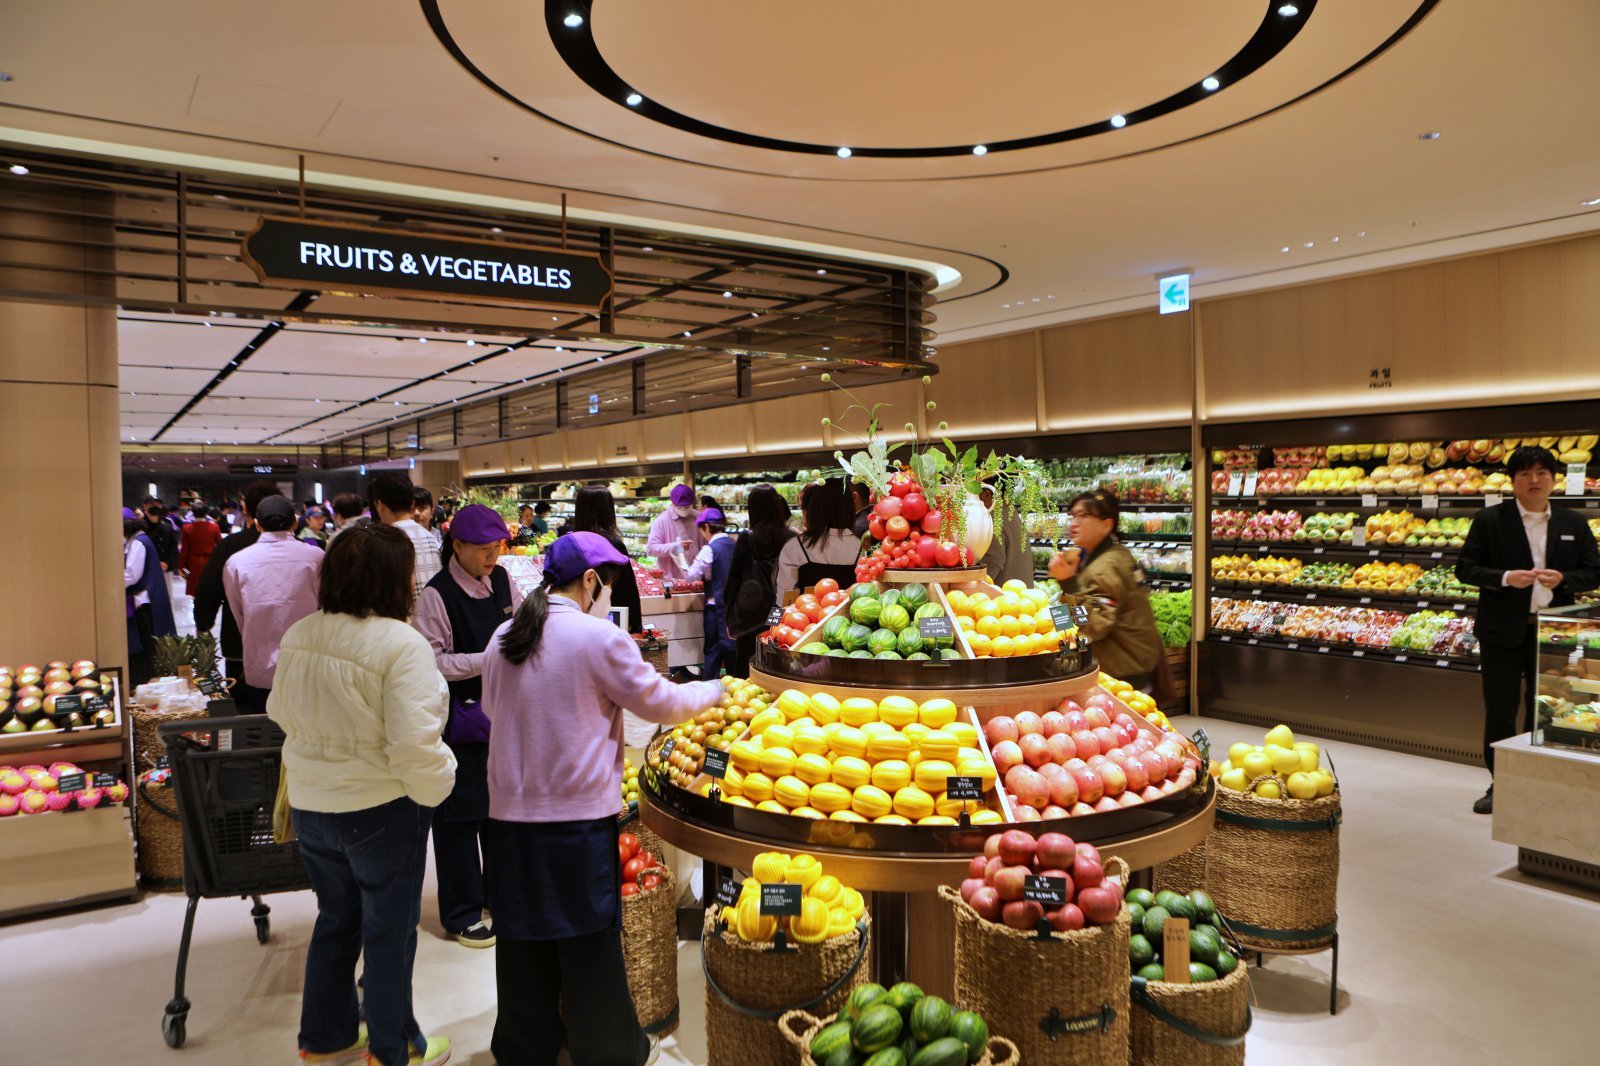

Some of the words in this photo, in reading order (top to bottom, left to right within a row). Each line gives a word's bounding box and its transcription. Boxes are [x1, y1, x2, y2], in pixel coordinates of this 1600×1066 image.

[300, 241, 394, 272] FRUITS
[400, 253, 419, 275] &
[420, 254, 572, 289] VEGETABLES
[1369, 381, 1392, 389] FRUITS
